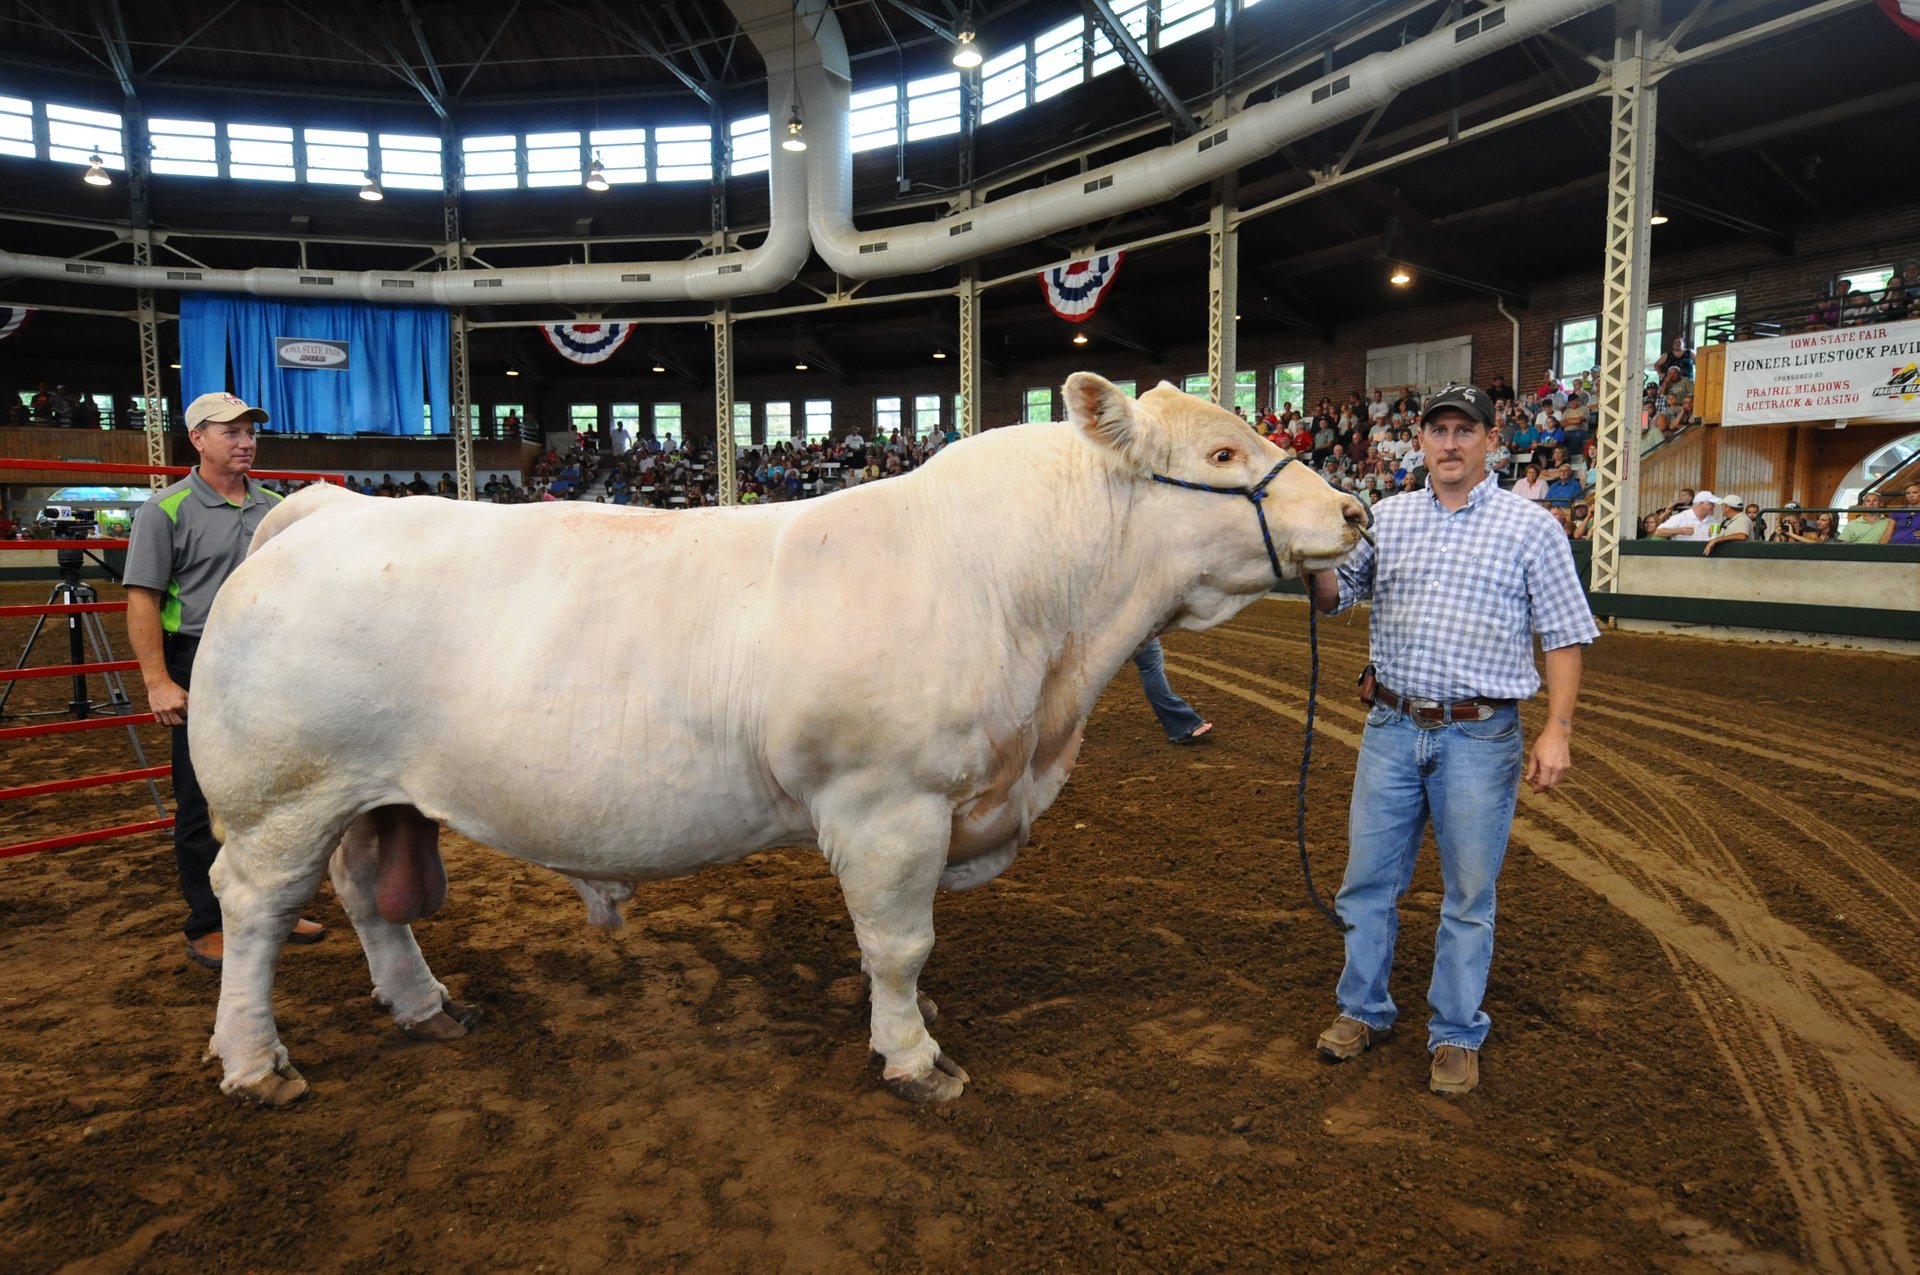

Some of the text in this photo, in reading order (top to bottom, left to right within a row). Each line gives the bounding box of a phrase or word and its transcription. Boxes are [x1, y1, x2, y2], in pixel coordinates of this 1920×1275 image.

[1790, 328, 1888, 349] IOWA STATE FAIR
[302, 345, 324, 355] STATE
[325, 347, 342, 357] FAIR
[1733, 356, 1792, 372] PIONEER
[1795, 346, 1876, 367] LIVESTOCK
[1774, 372, 1813, 382] SPONSORED
[1746, 380, 1850, 398] PRAIRIE MEADOWS
[1873, 385, 1903, 396] PRAIRIE
[1737, 393, 1860, 412] RACETRACK & CASINO
